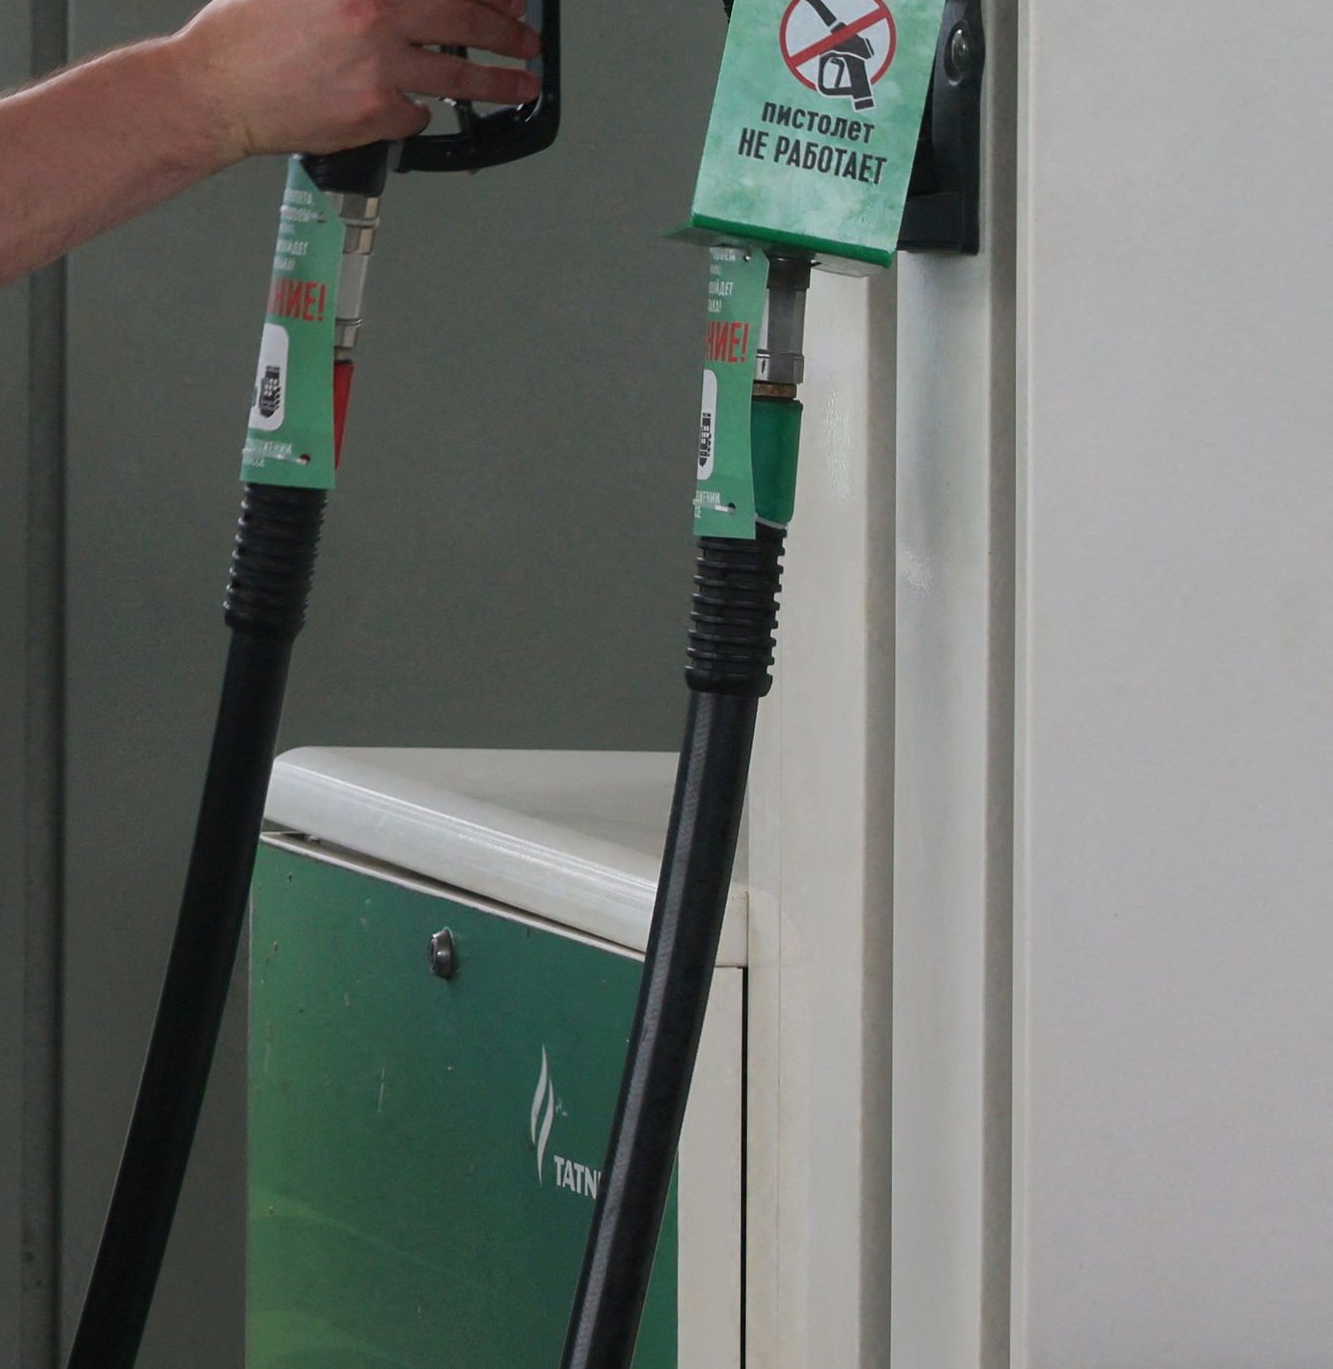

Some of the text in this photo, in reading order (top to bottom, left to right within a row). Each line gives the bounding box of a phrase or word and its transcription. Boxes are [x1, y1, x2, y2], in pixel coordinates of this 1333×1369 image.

[761, 101, 875, 144] пистолет
[738, 128, 887, 185] НЕ РАБОТАЕТ
